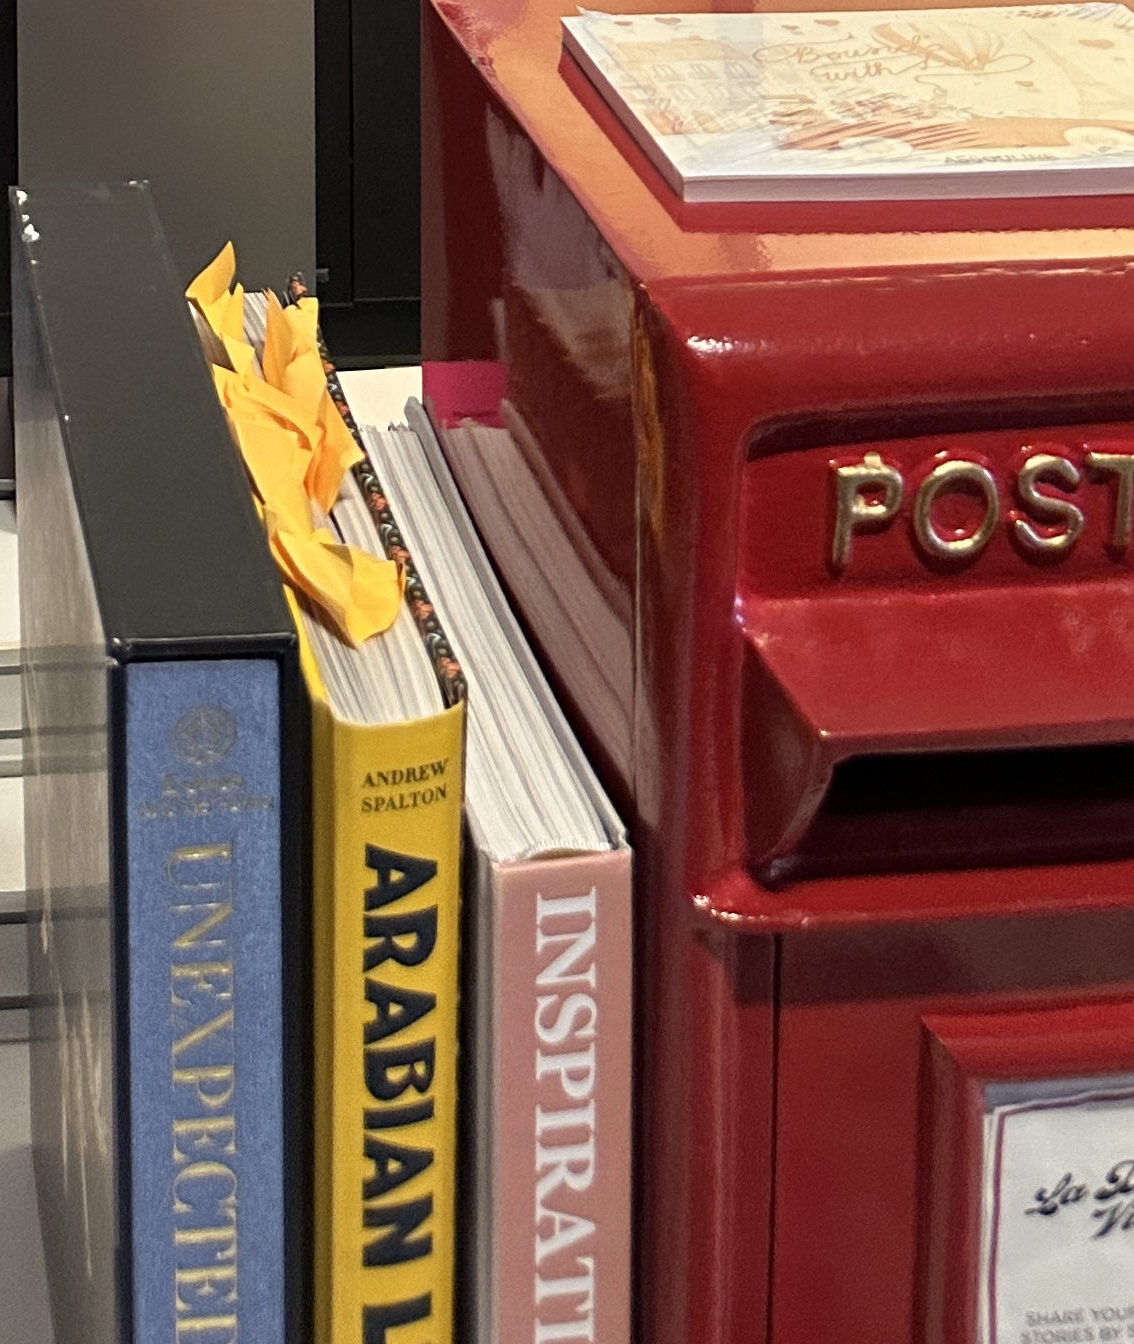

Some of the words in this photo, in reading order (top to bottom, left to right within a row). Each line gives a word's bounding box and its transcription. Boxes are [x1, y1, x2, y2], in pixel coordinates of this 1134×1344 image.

[831, 451, 1134, 567] POST
[359, 781, 447, 815] SPALTON
[360, 756, 450, 789] ANDREW
[361, 842, 439, 1270] ARABIAN
[534, 885, 598, 1344] INSPIRATI
[361, 1290, 434, 1344] L
[1025, 1308, 1086, 1328] SHARE
